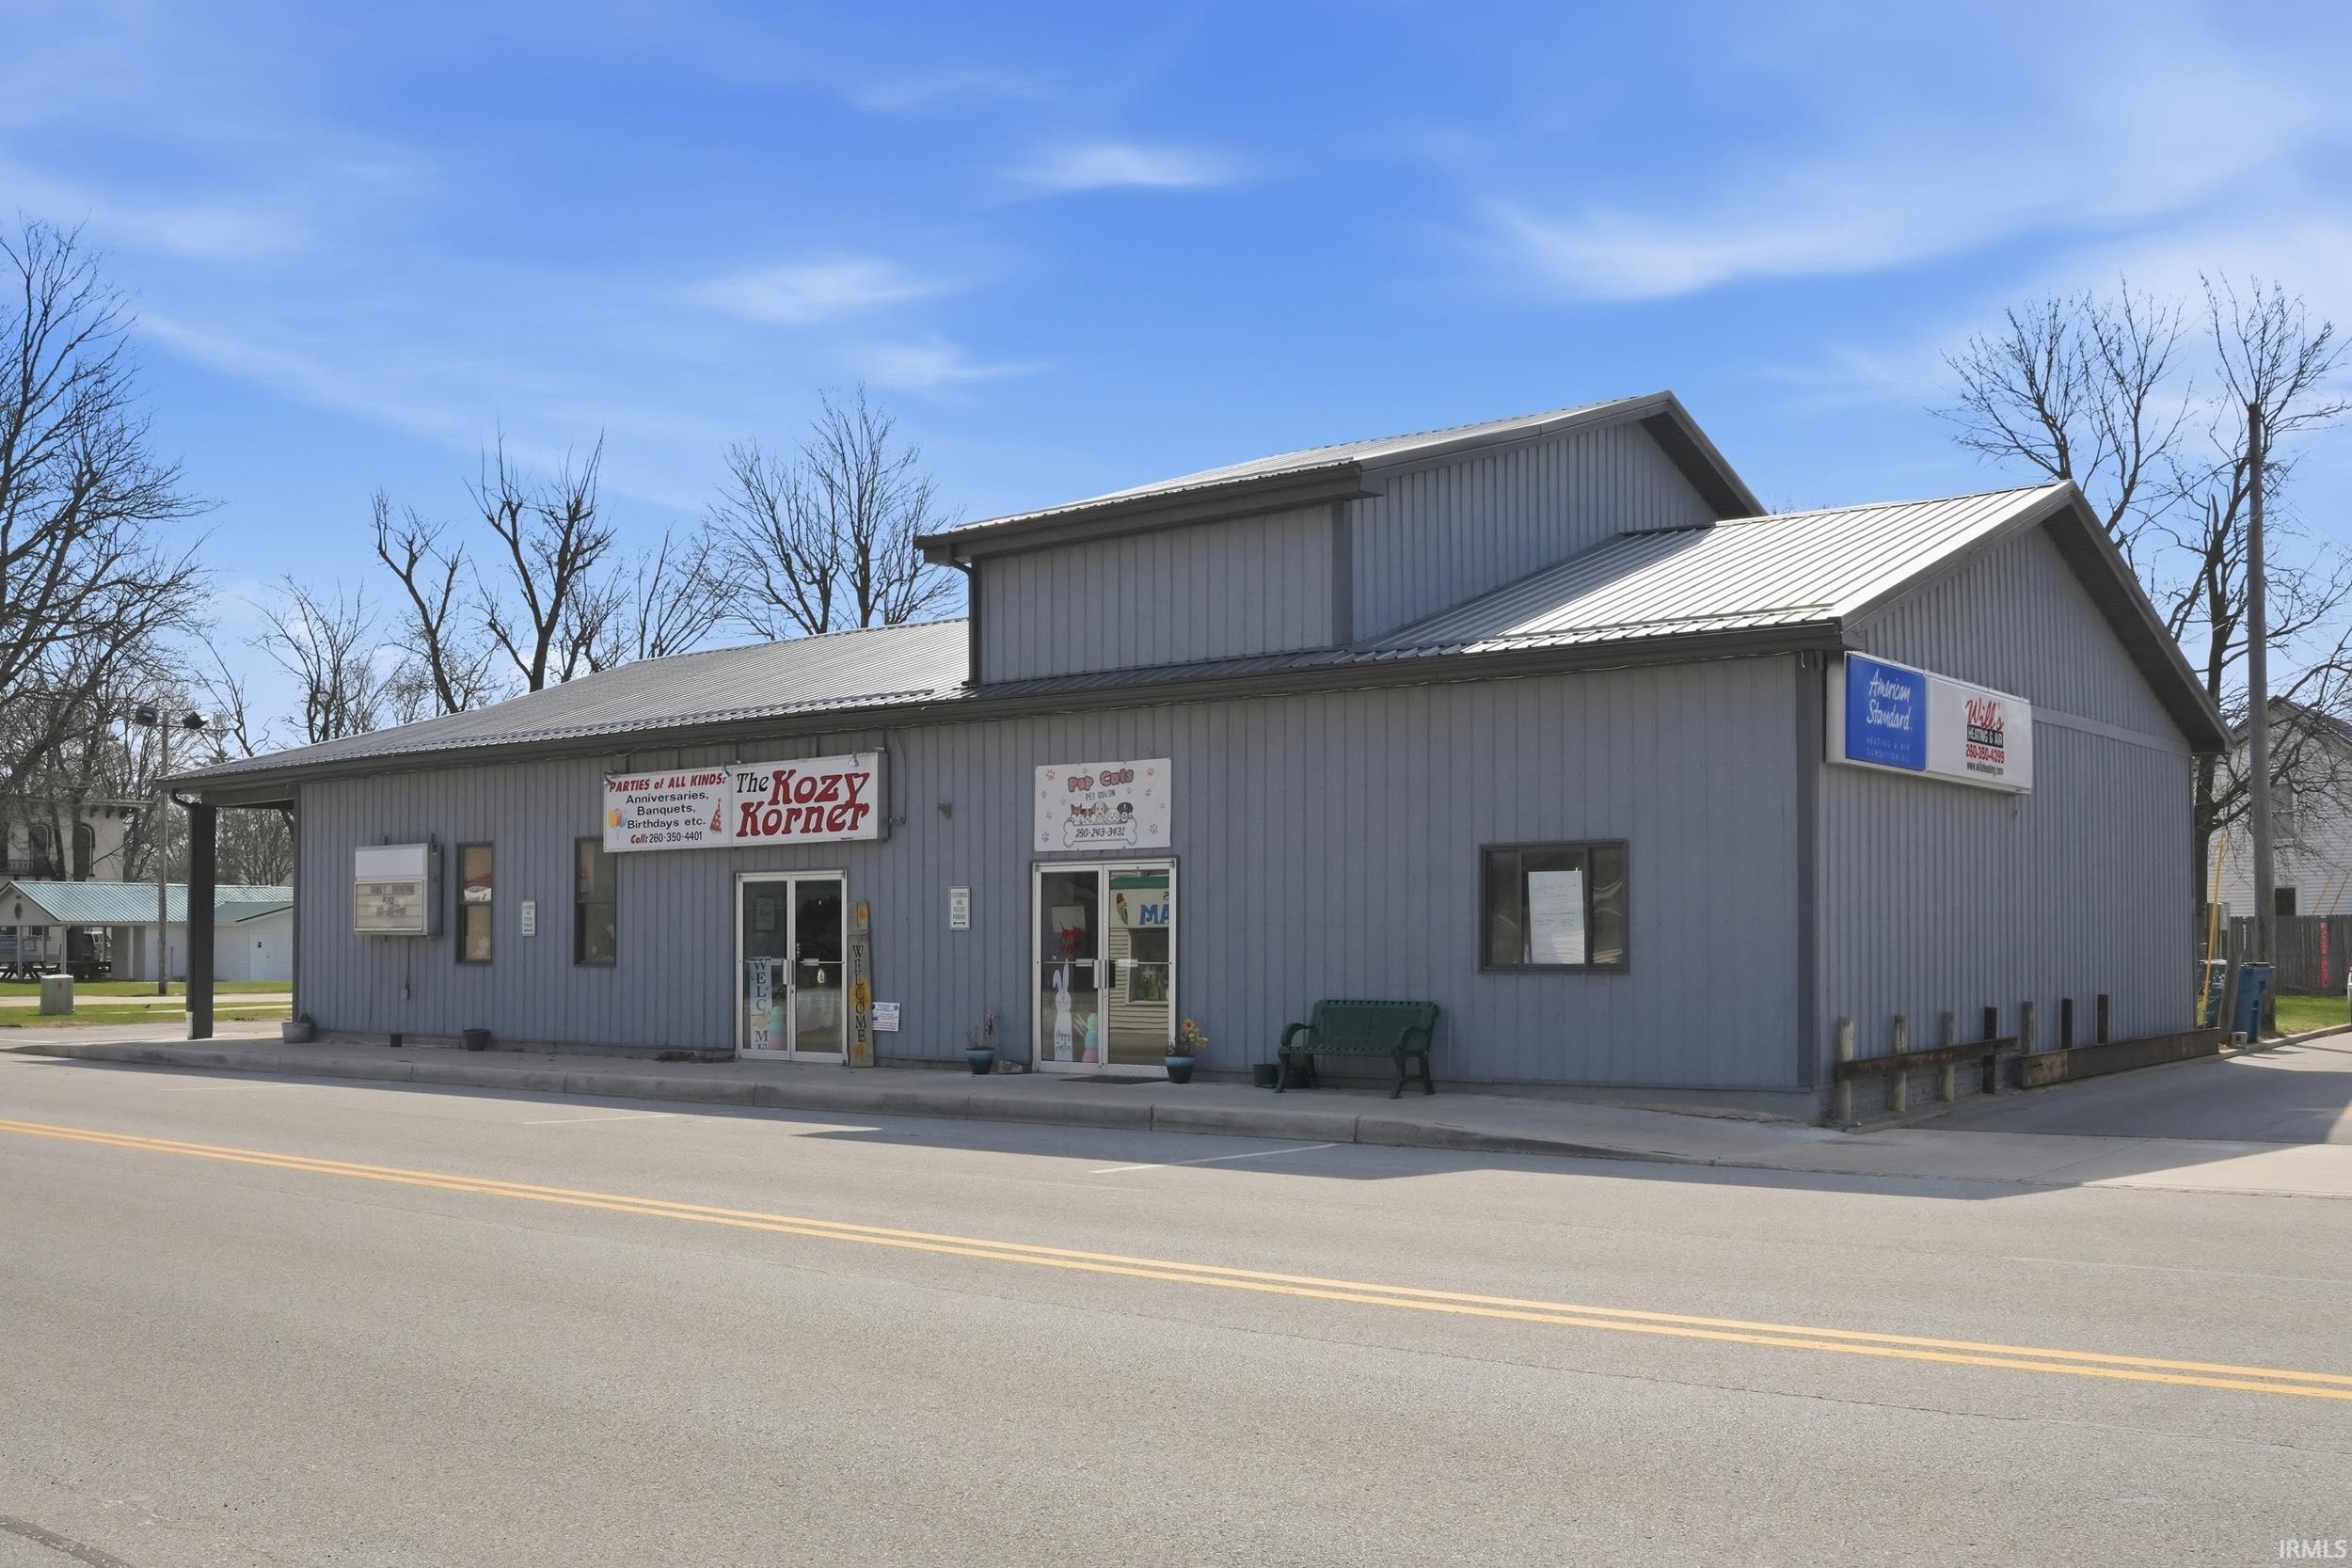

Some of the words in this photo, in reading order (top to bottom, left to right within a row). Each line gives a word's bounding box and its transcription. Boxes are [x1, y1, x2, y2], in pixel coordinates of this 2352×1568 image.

[1868, 668, 1911, 703] American
[1964, 696, 2005, 732] Will's
[1967, 726, 1988, 743] HEATING
[1994, 733, 2003, 746] AIR
[609, 778, 650, 792] PARTIES
[654, 777, 664, 790] of
[668, 776, 686, 788] ALL
[736, 772, 770, 793] The
[768, 768, 870, 809] Kozy
[1068, 775, 1094, 793] Pup
[1099, 768, 1135, 787] Cuts
[1085, 792, 1096, 800] PET
[628, 817, 679, 830] Birthdays
[684, 817, 707, 827] etc.
[736, 800, 870, 837] Korner
[649, 831, 703, 844] 260-350-4401
[1075, 827, 1126, 838] 260-243-3431
[852, 945, 866, 1042] WELCOME
